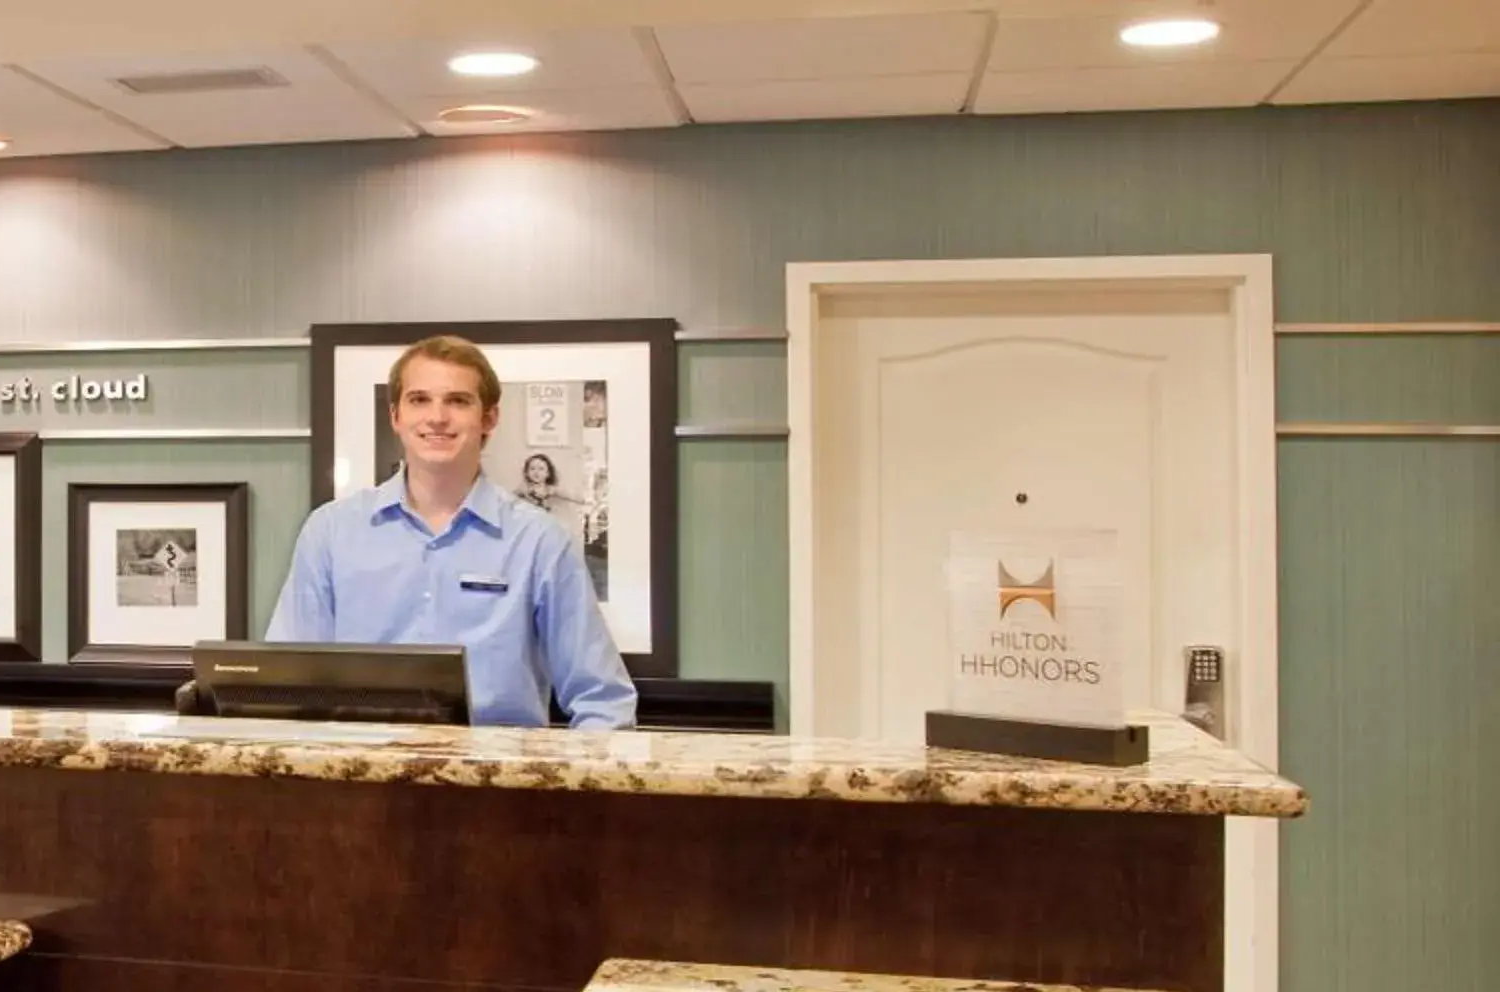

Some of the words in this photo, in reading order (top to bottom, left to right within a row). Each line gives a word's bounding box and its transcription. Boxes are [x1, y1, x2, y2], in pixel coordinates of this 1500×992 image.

[52, 373, 149, 400] cloud
[540, 408, 556, 431] 2
[990, 631, 1067, 651] HILTON
[961, 654, 1101, 684] HHONORS
